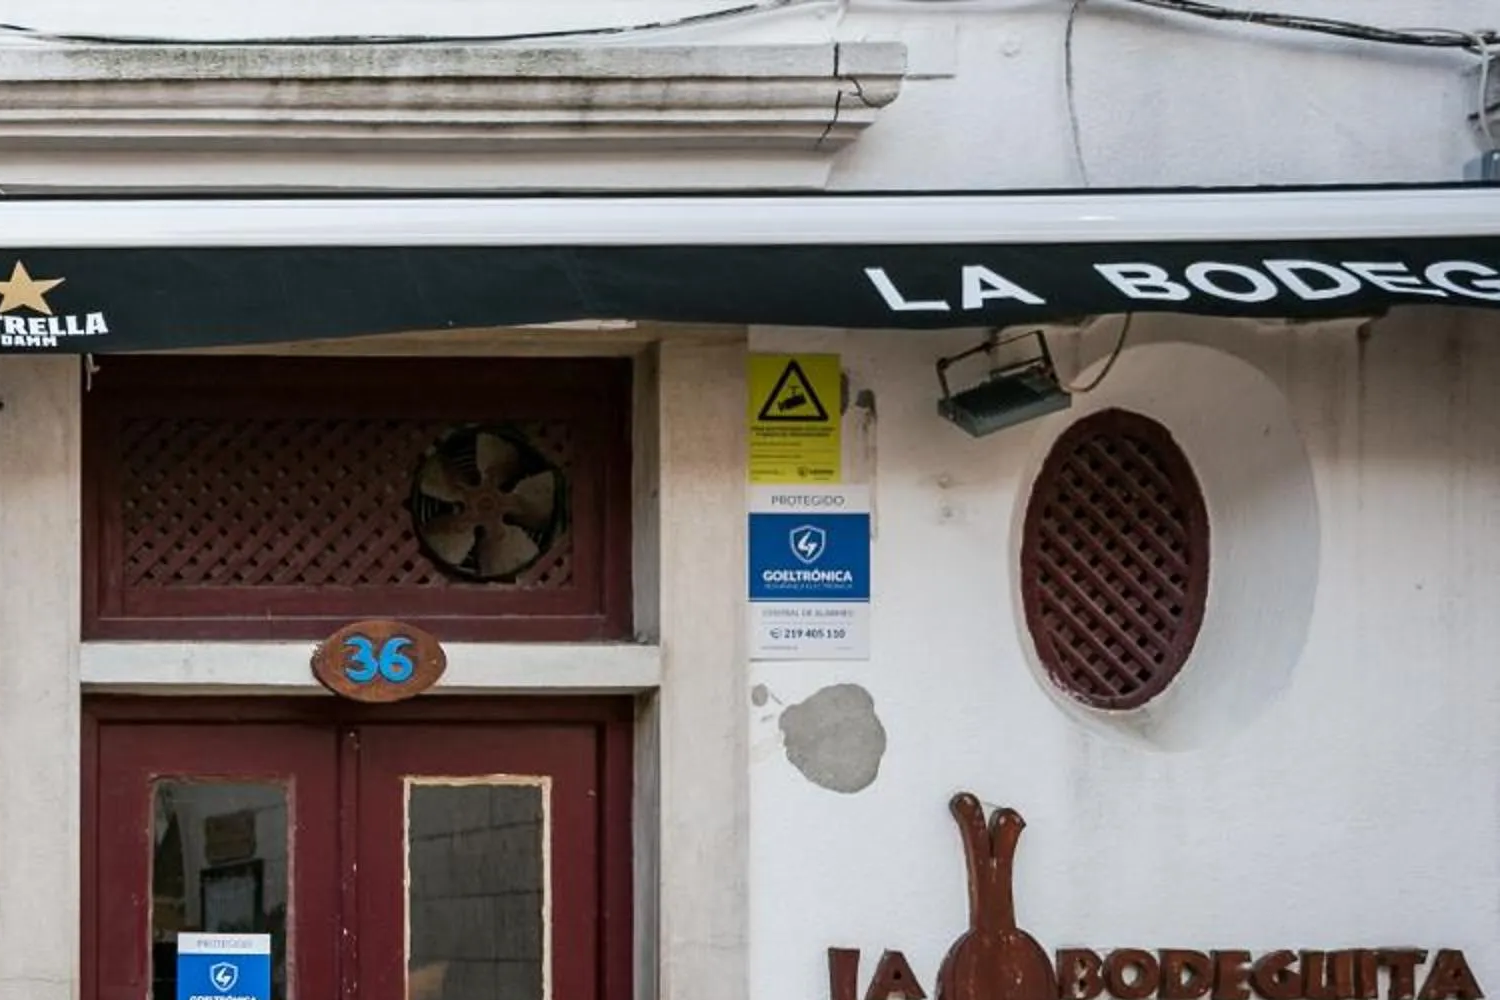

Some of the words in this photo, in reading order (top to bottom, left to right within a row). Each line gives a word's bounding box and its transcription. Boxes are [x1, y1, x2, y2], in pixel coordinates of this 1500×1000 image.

[864, 265, 1046, 311] LA
[1094, 259, 1500, 302] BODEG
[1, 335, 58, 347] DAMM
[771, 495, 845, 506] PROTEGIDO
[343, 635, 414, 684] 36
